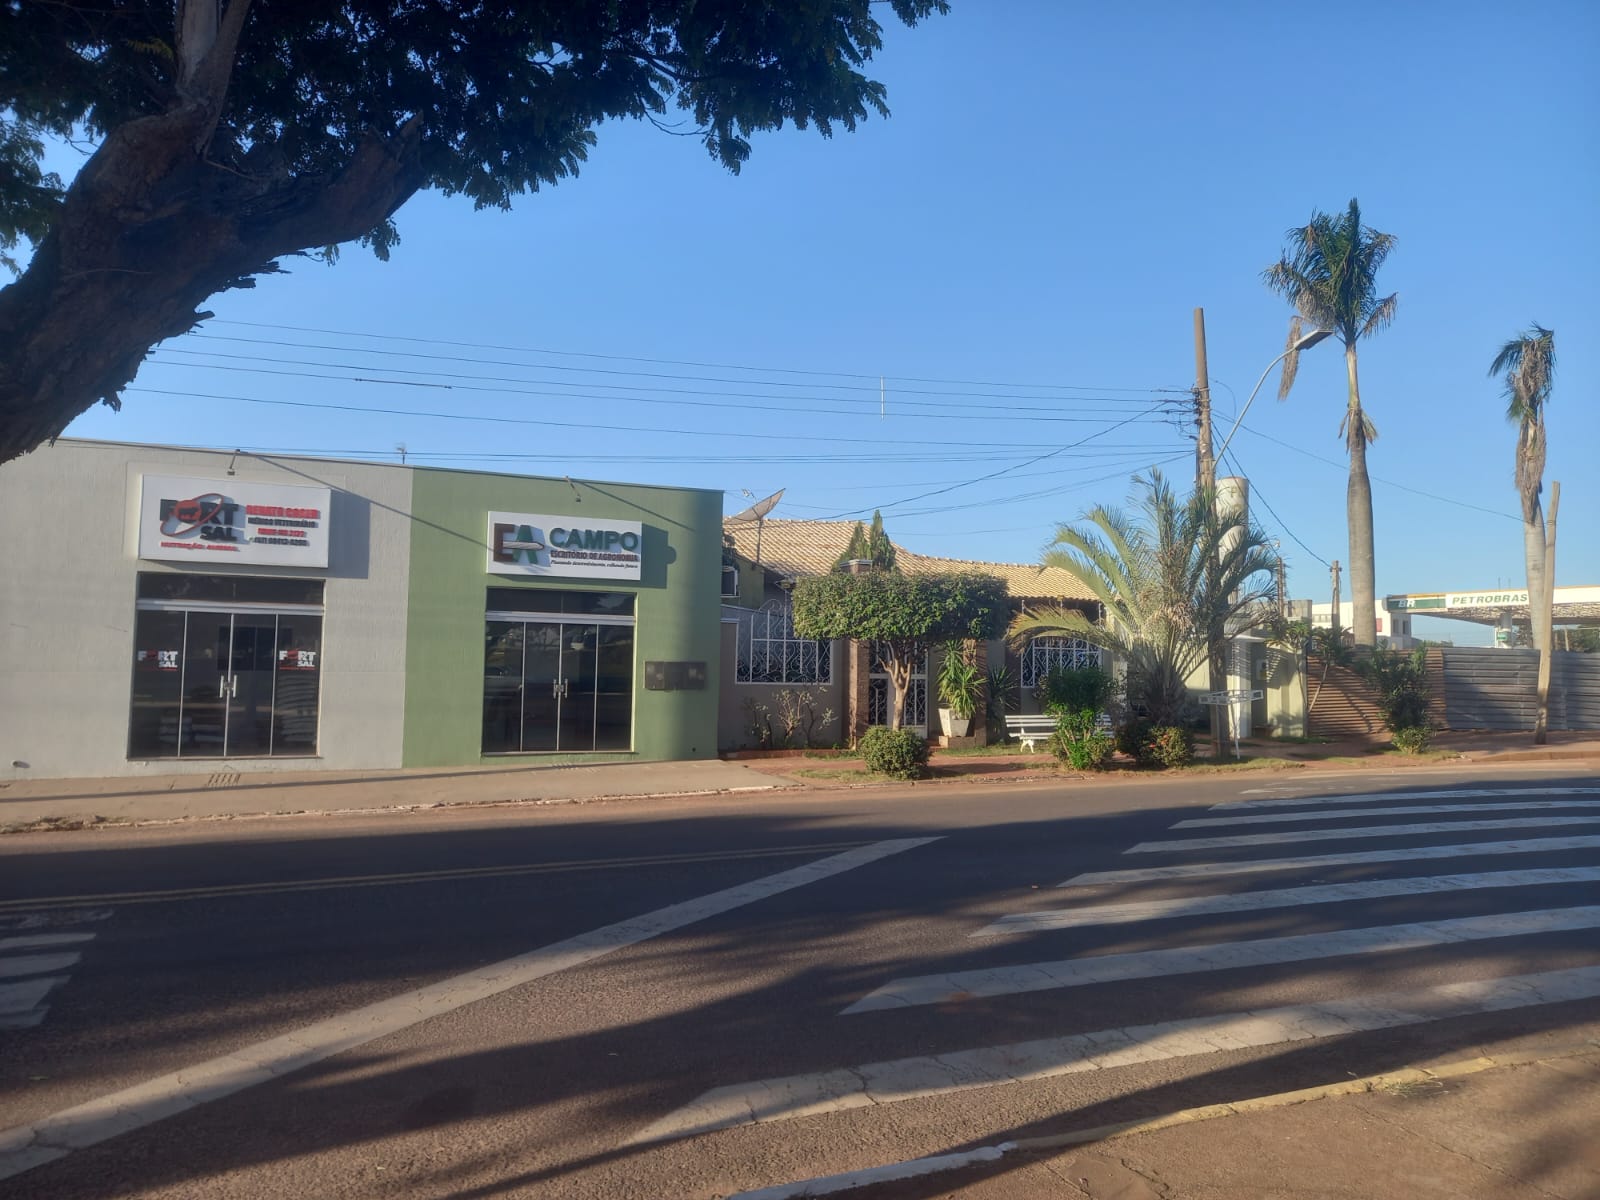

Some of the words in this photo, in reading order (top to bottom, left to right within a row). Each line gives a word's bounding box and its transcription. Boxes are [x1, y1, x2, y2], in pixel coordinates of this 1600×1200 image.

[200, 525, 238, 542] SAL
[549, 527, 639, 551] CAMPO
[550, 549, 587, 560] ESCRITÓRIO
[588, 552, 598, 560] DE
[598, 553, 639, 562] AGRONOMIA
[1398, 600, 1416, 608] BR
[1452, 593, 1528, 605] PETROBRAS
